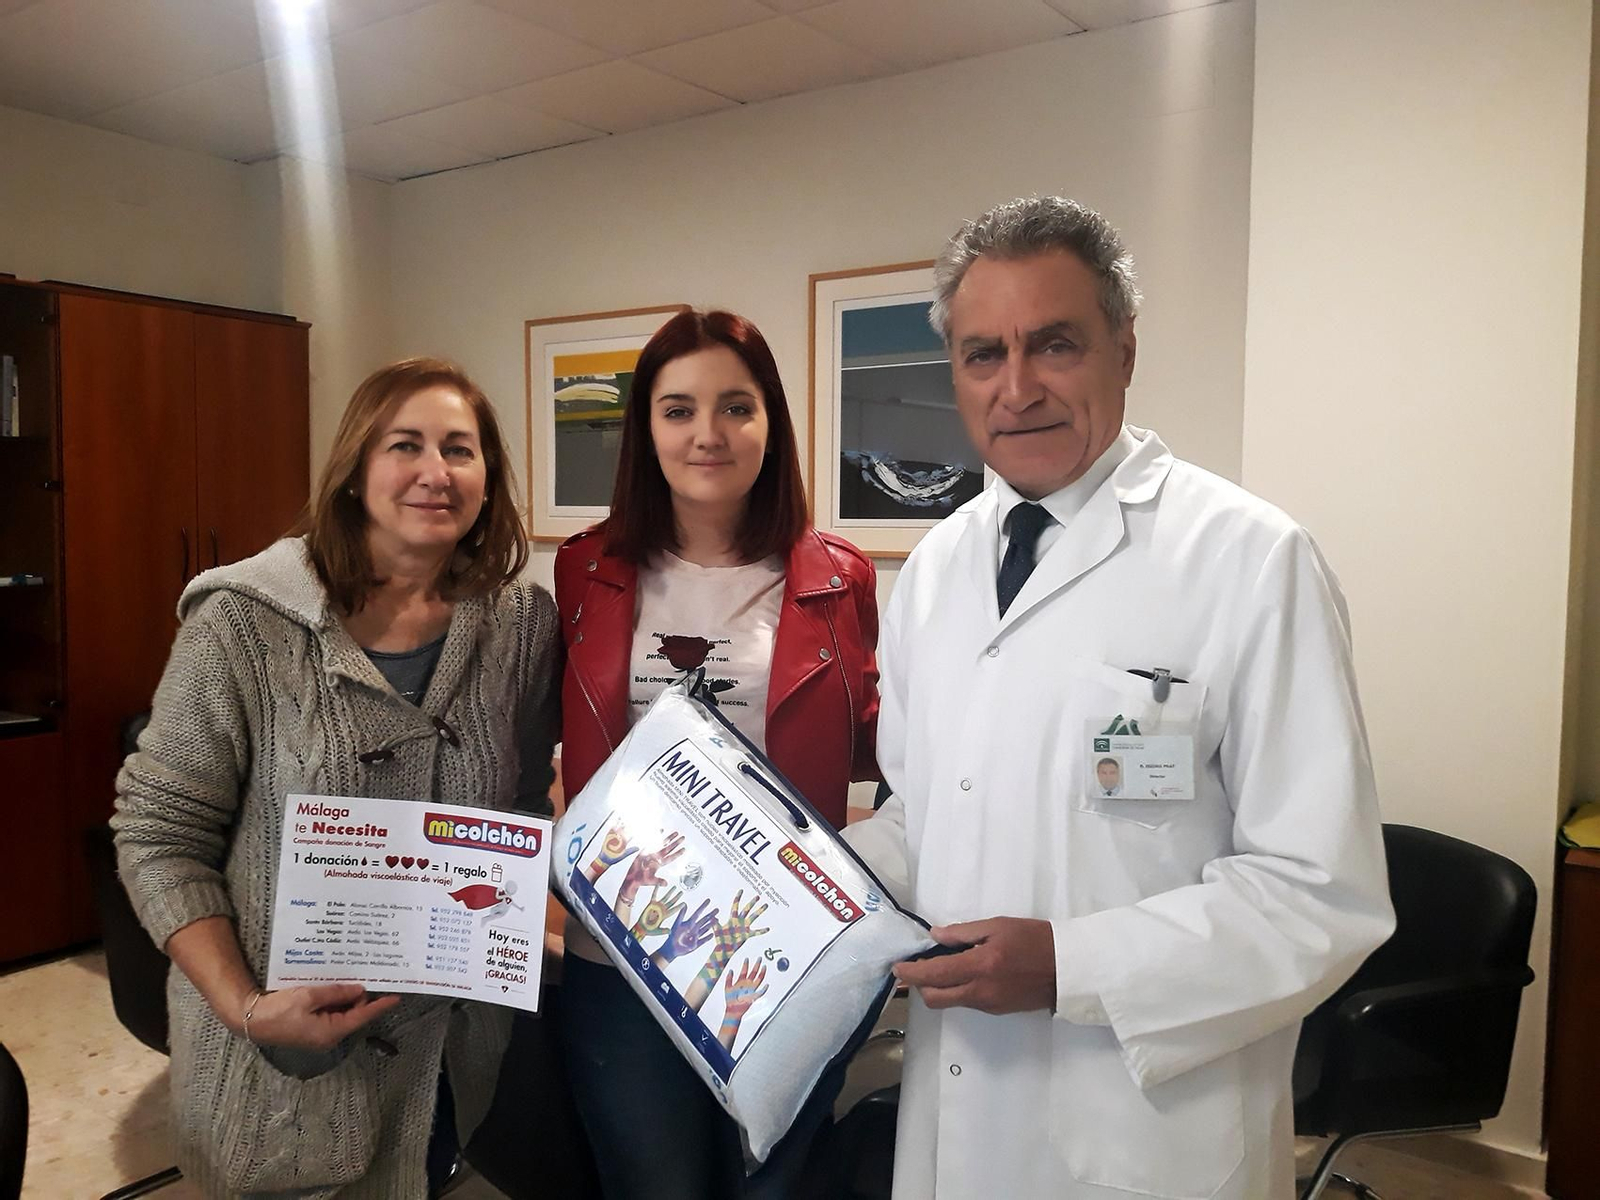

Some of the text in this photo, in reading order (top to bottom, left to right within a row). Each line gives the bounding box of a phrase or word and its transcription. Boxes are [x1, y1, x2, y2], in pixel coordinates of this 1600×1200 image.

[296, 802, 350, 820] Málaga
[662, 751, 771, 865] MINI TRAVEL
[294, 821, 388, 837] te Necesita
[428, 819, 537, 851] micolchón
[293, 837, 324, 846] Campaña
[325, 838, 353, 846] donación
[364, 840, 386, 849] Sangre
[294, 852, 299, 864] 1
[304, 852, 359, 867] donación
[444, 862, 449, 873] 1
[453, 865, 487, 879] regalo
[324, 869, 368, 879] (Almohada
[420, 875, 431, 883] de
[432, 876, 453, 887] viaje)
[781, 847, 854, 920] micolchón
[488, 929, 529, 946] Hoy eres
[487, 946, 529, 963] el HÉROE
[486, 958, 528, 973] de alguien,
[485, 969, 527, 985] ¡GRACIAS!
